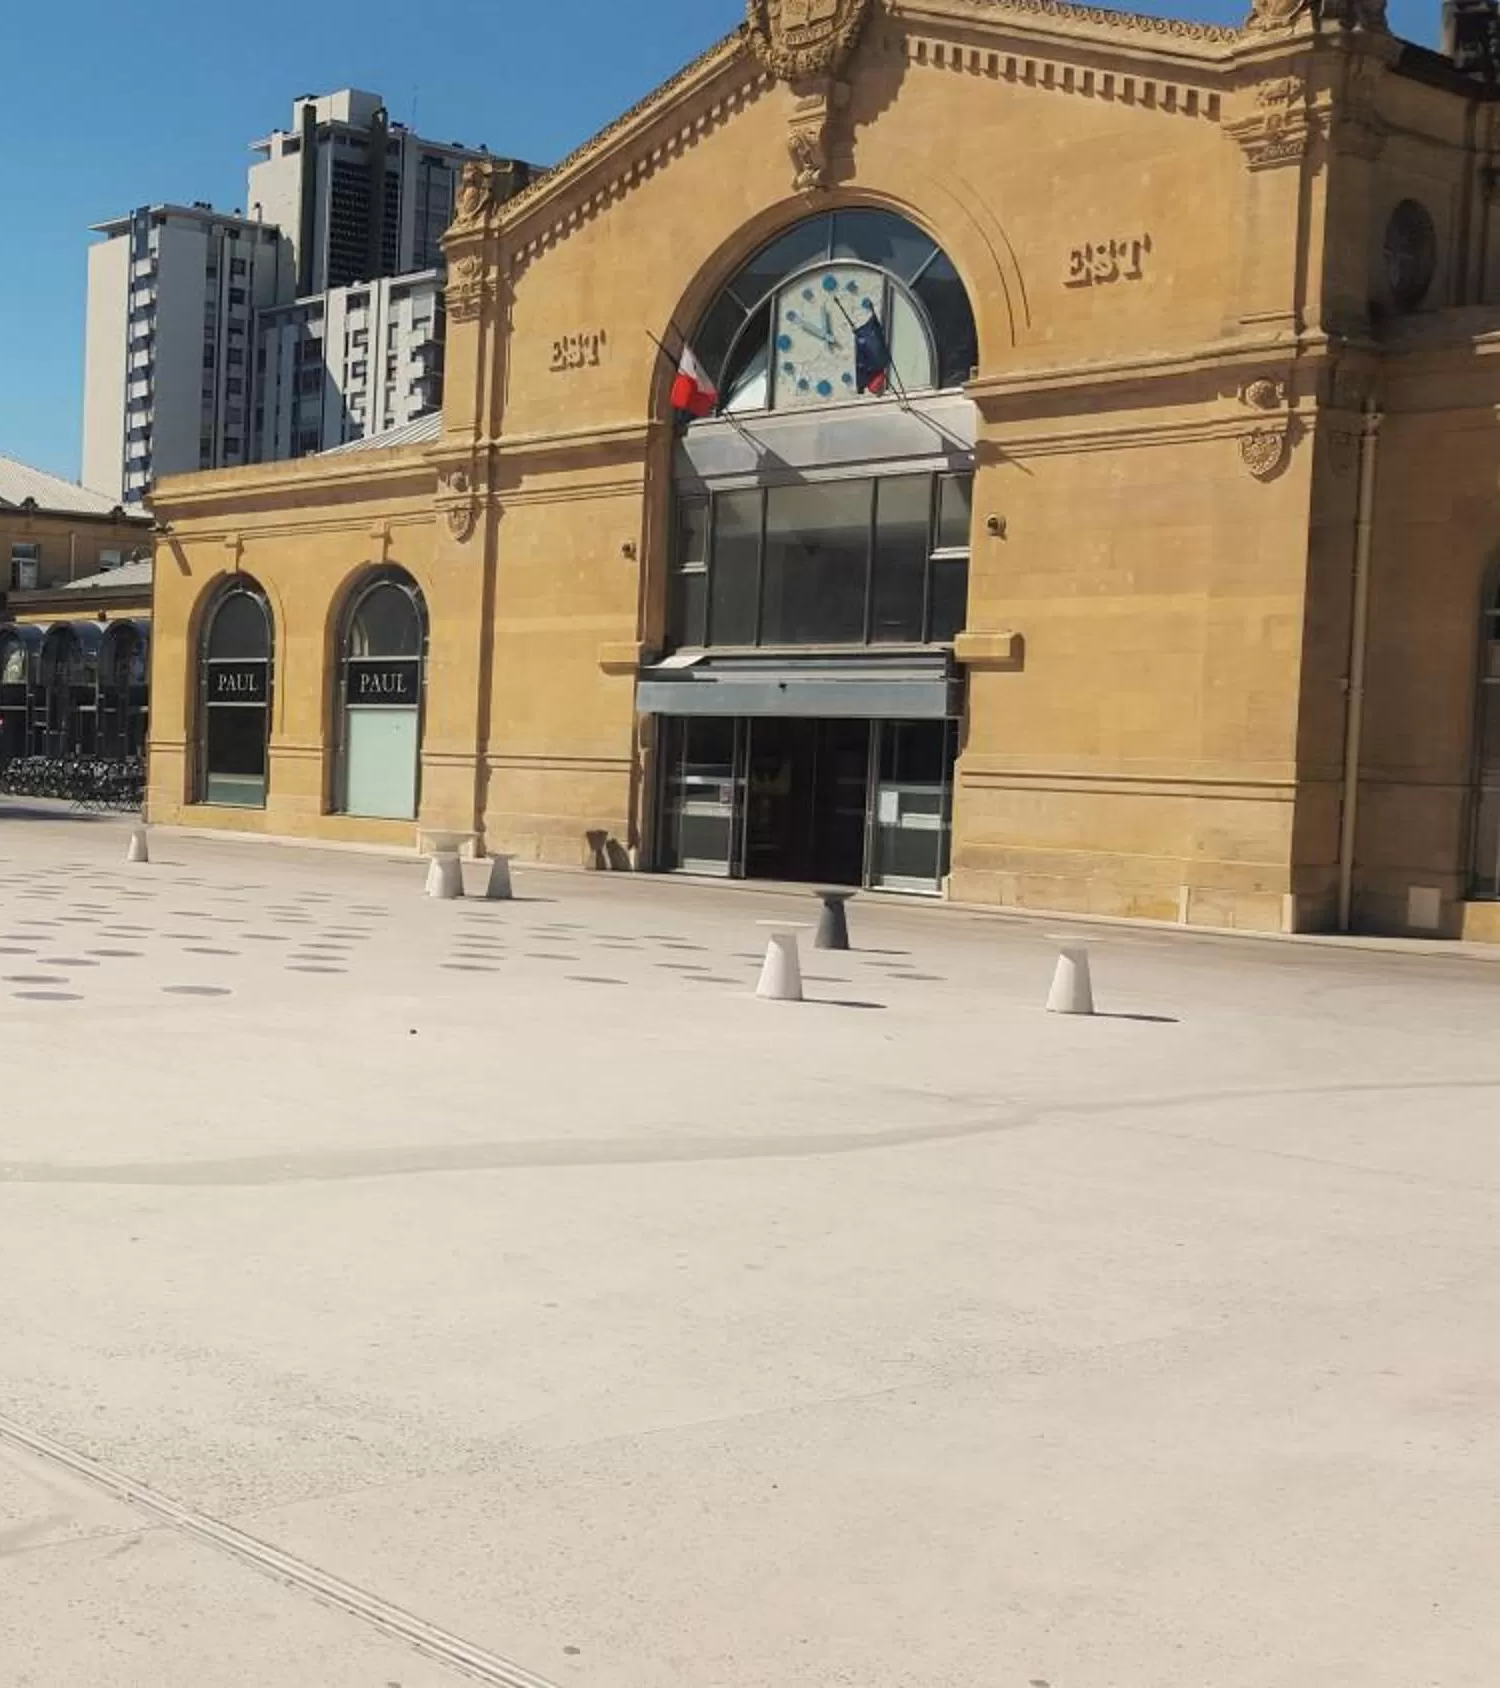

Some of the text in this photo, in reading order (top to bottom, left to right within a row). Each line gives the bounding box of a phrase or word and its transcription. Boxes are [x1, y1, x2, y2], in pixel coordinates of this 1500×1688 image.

[1061, 232, 1152, 289] EST
[547, 328, 607, 373] EST
[218, 673, 259, 692] PAUL
[360, 672, 407, 693] PAUL
